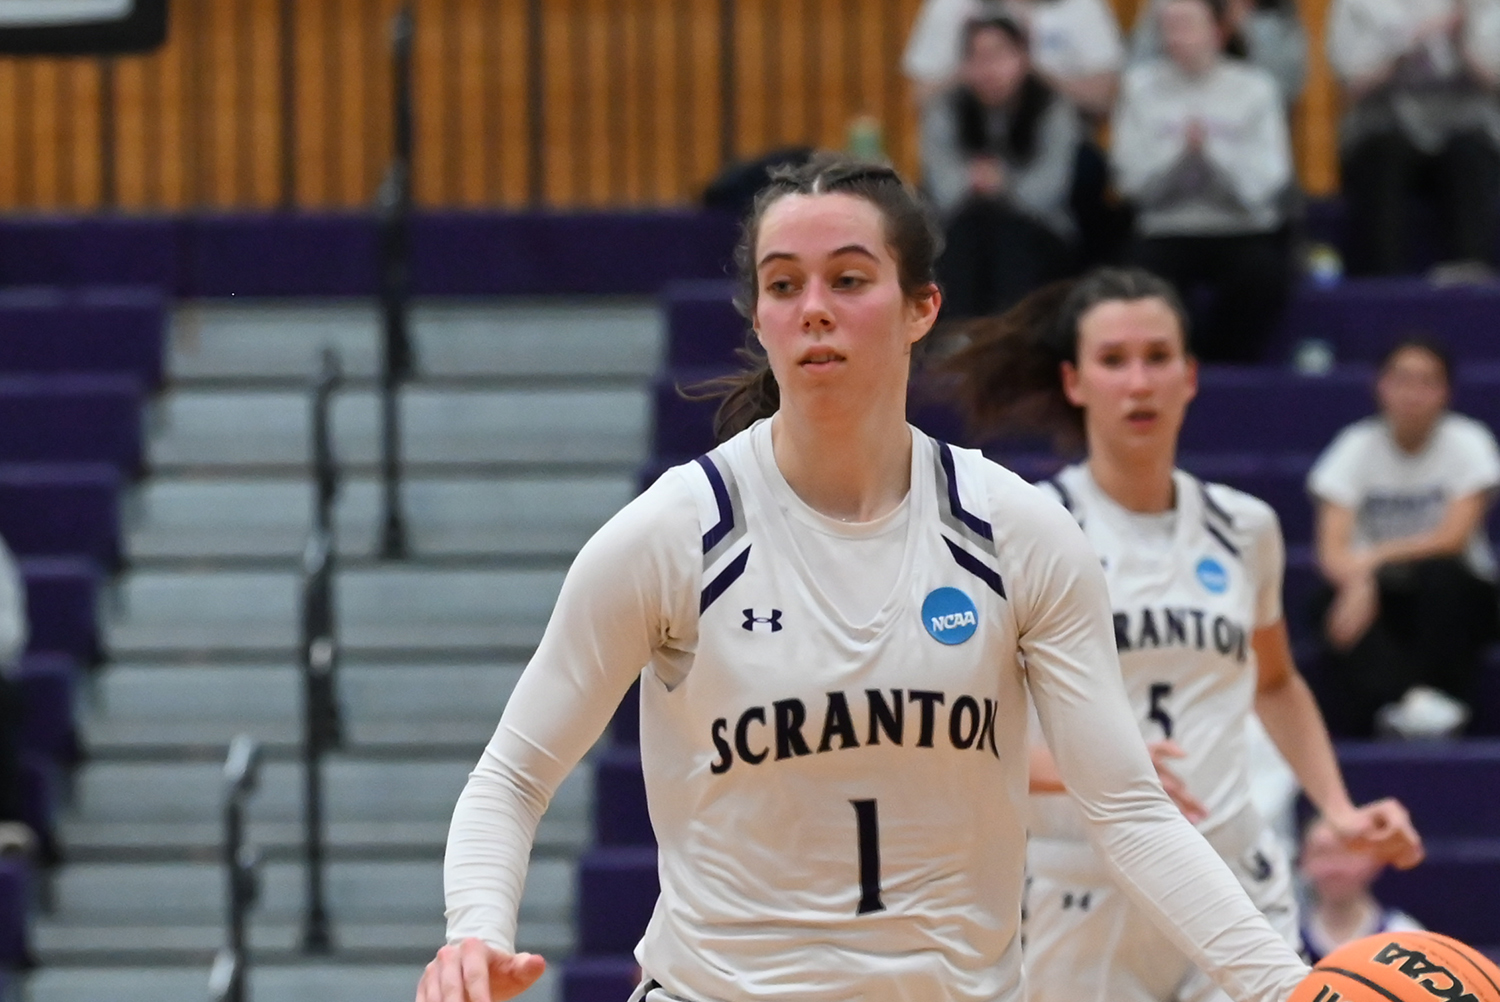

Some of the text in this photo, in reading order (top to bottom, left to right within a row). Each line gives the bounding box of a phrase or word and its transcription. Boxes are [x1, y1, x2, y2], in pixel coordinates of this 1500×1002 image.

[931, 610, 976, 632] NCAA
[710, 688, 1000, 775] SCRANTON
[1148, 682, 1174, 740] 5
[848, 798, 887, 916] 1
